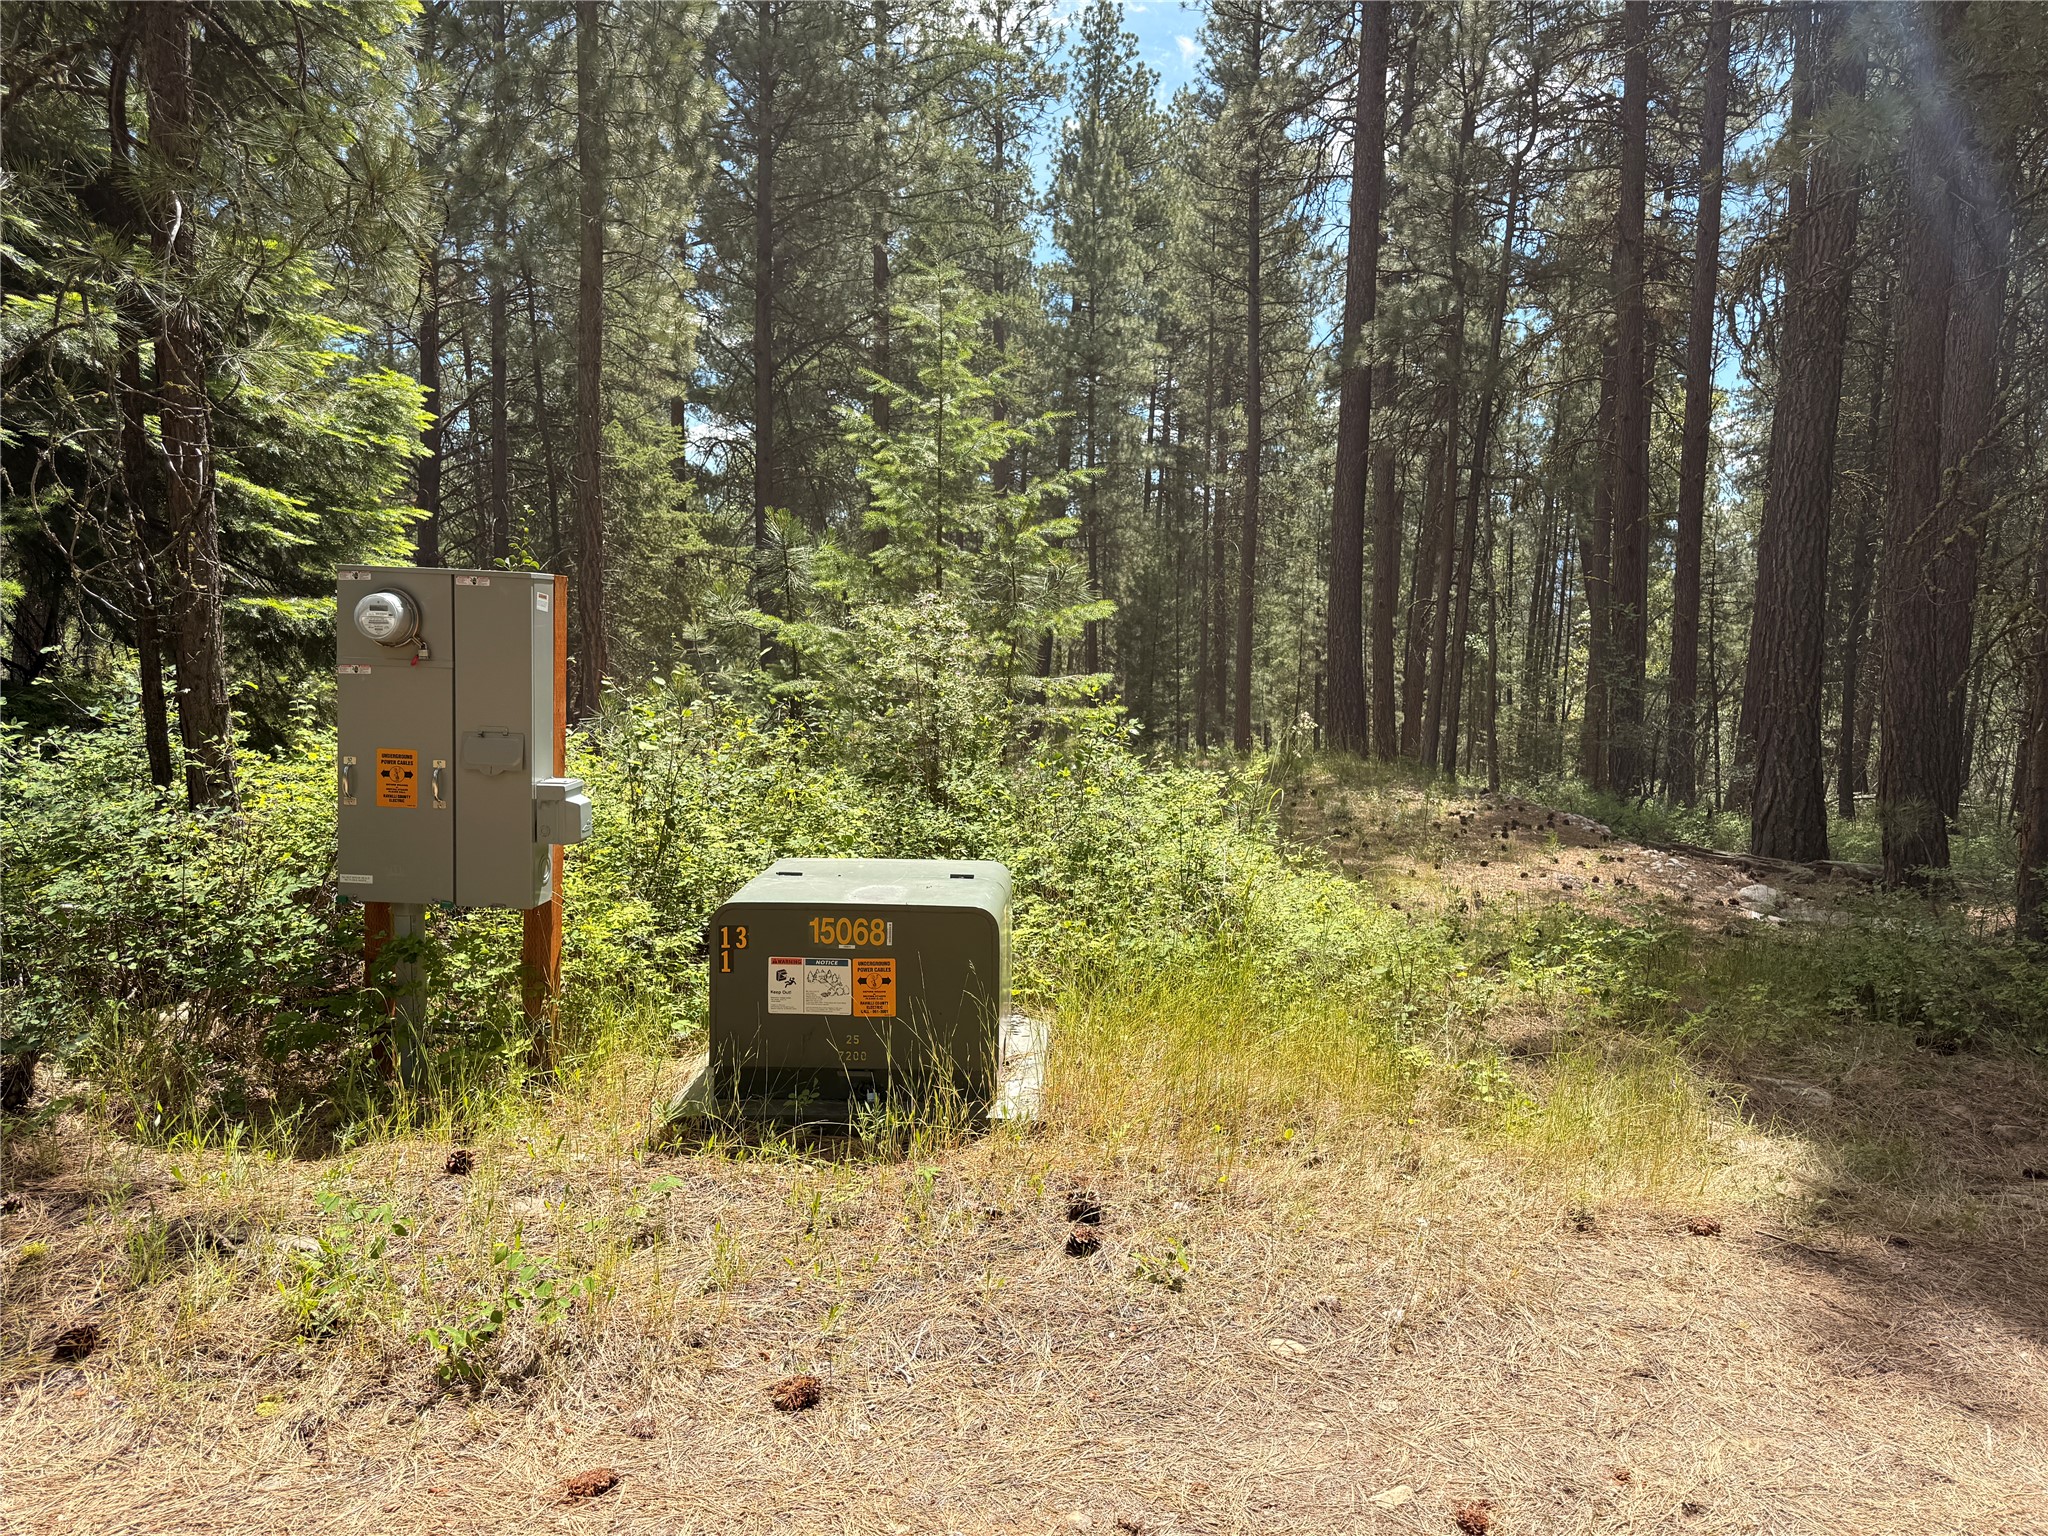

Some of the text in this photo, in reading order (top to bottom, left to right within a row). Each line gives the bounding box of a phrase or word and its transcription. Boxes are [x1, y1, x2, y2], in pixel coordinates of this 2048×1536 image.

[809, 917, 885, 946] 15068
[721, 950, 731, 973] 1
[846, 1034, 860, 1045] 25
